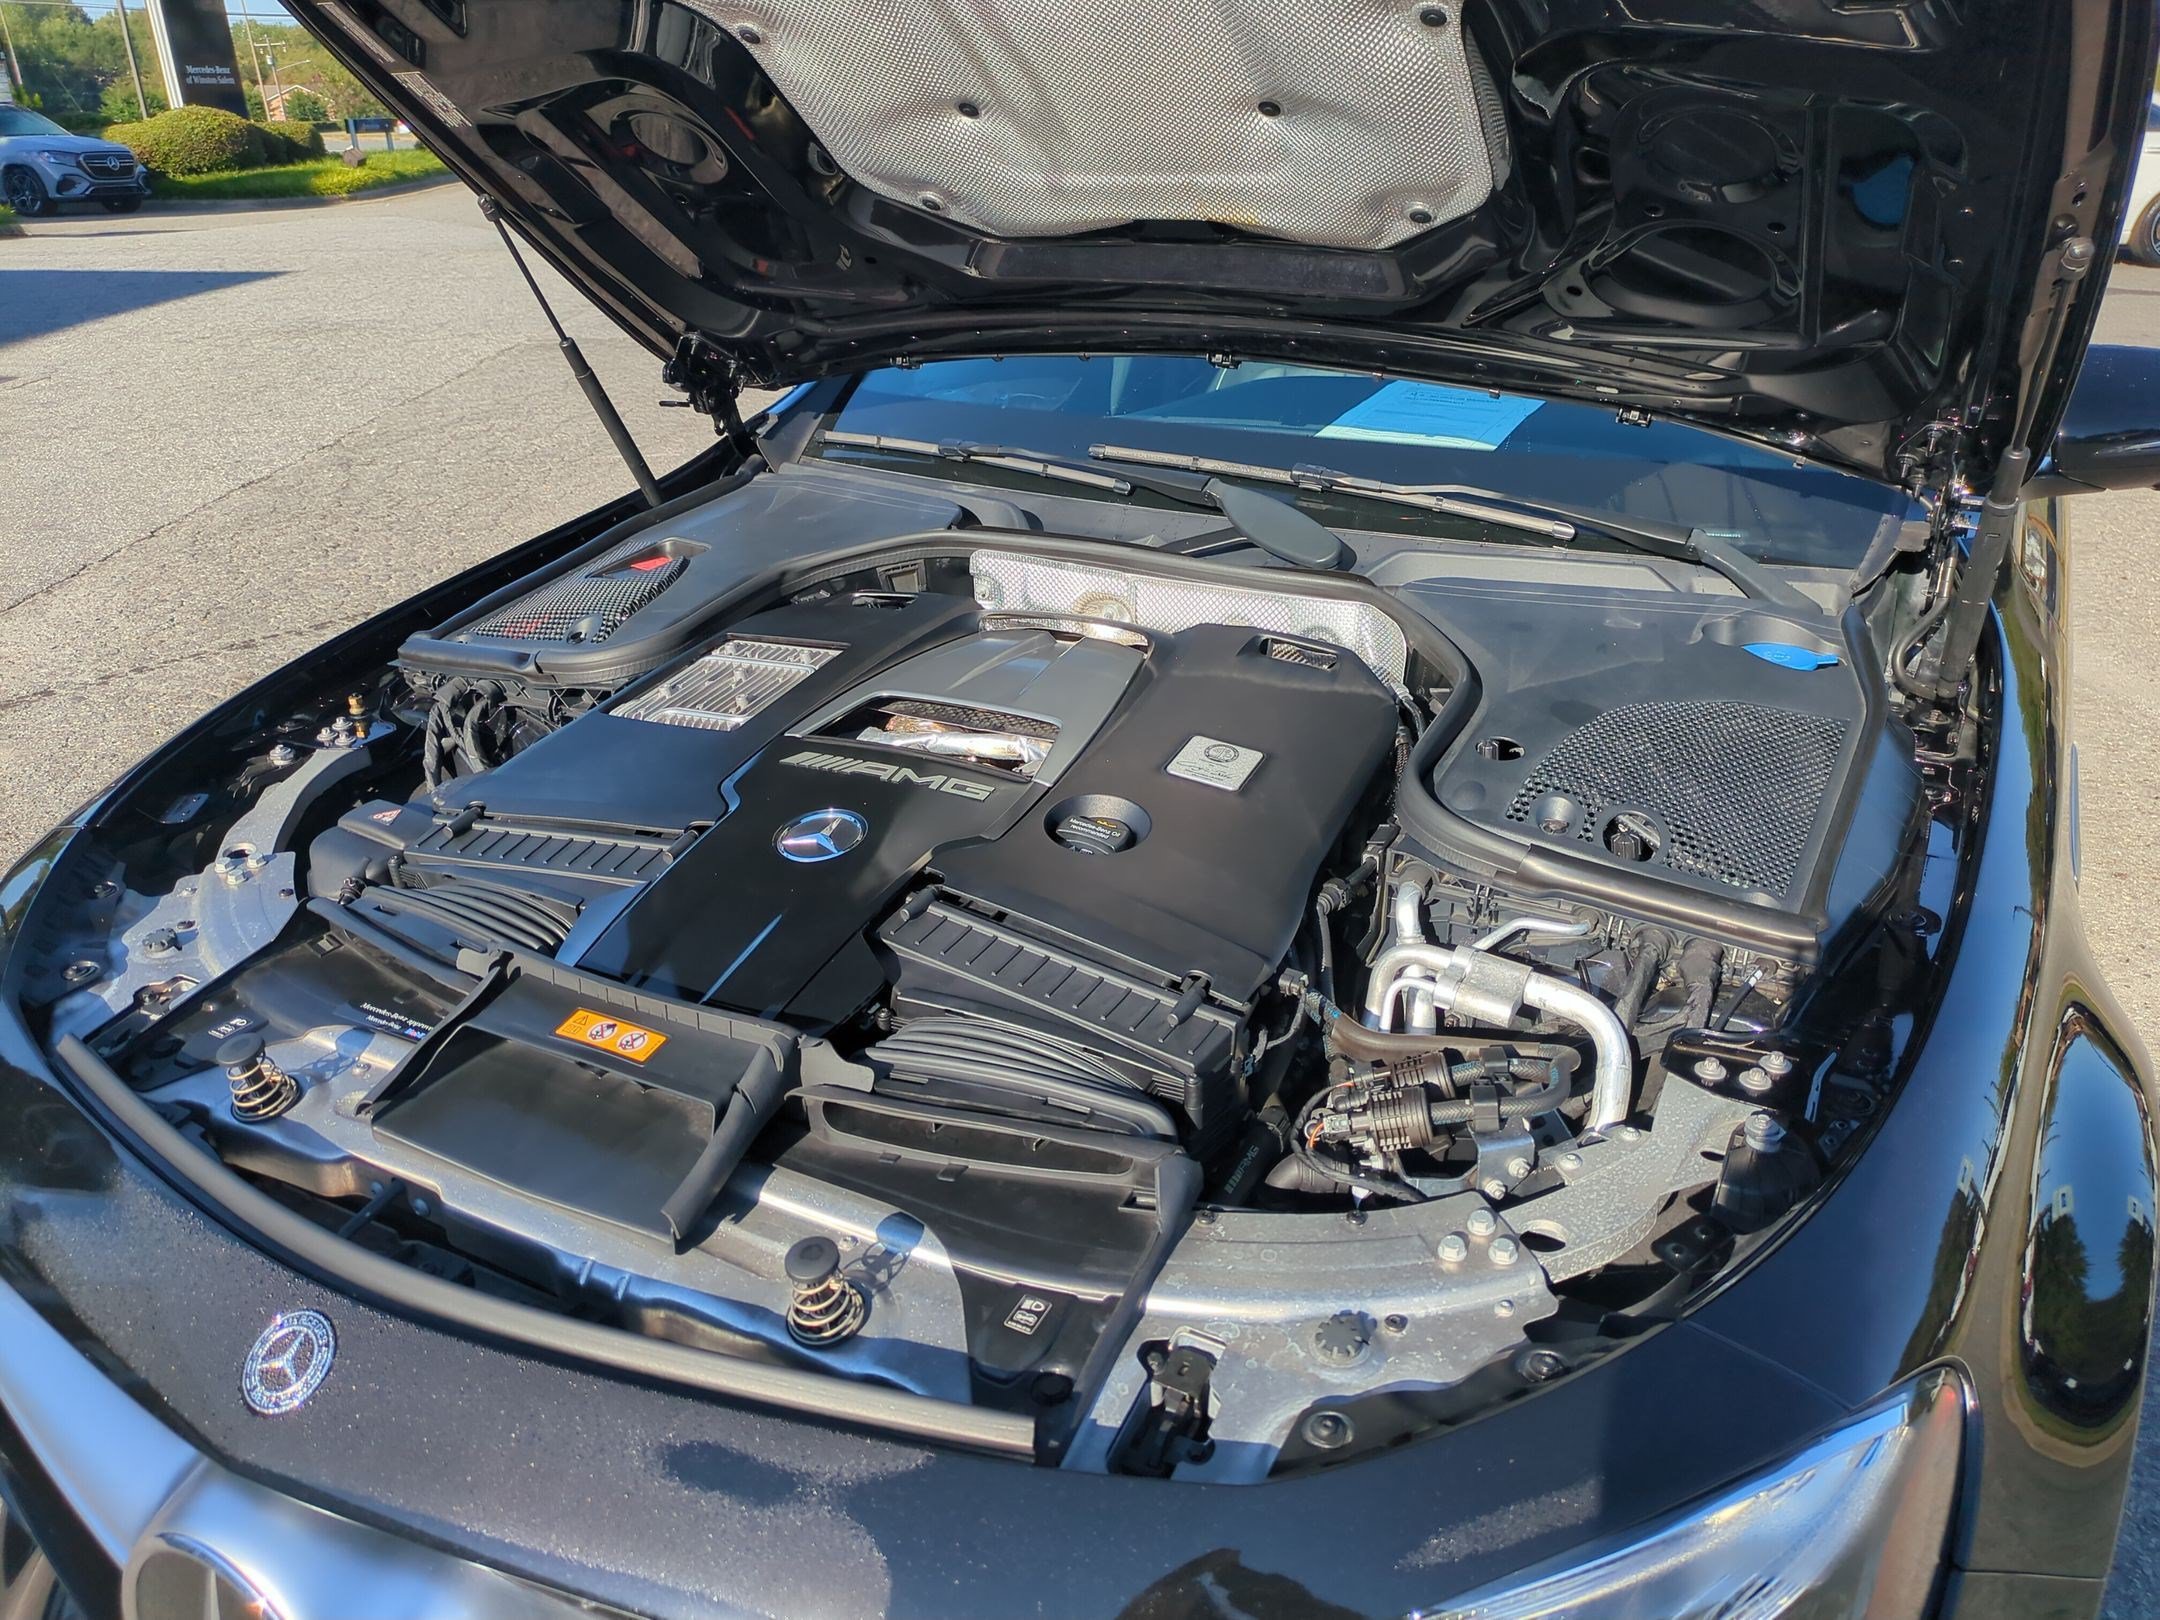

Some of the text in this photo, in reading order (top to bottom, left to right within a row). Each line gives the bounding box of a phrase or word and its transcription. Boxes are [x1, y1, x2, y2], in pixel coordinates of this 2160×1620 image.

[185, 65, 231, 74] Mercedes-Benz
[186, 75, 193, 84] of
[840, 759, 996, 802] AMG
[1069, 818, 1111, 835] Mercedes-Benz
[1070, 824, 1109, 839] recommended
